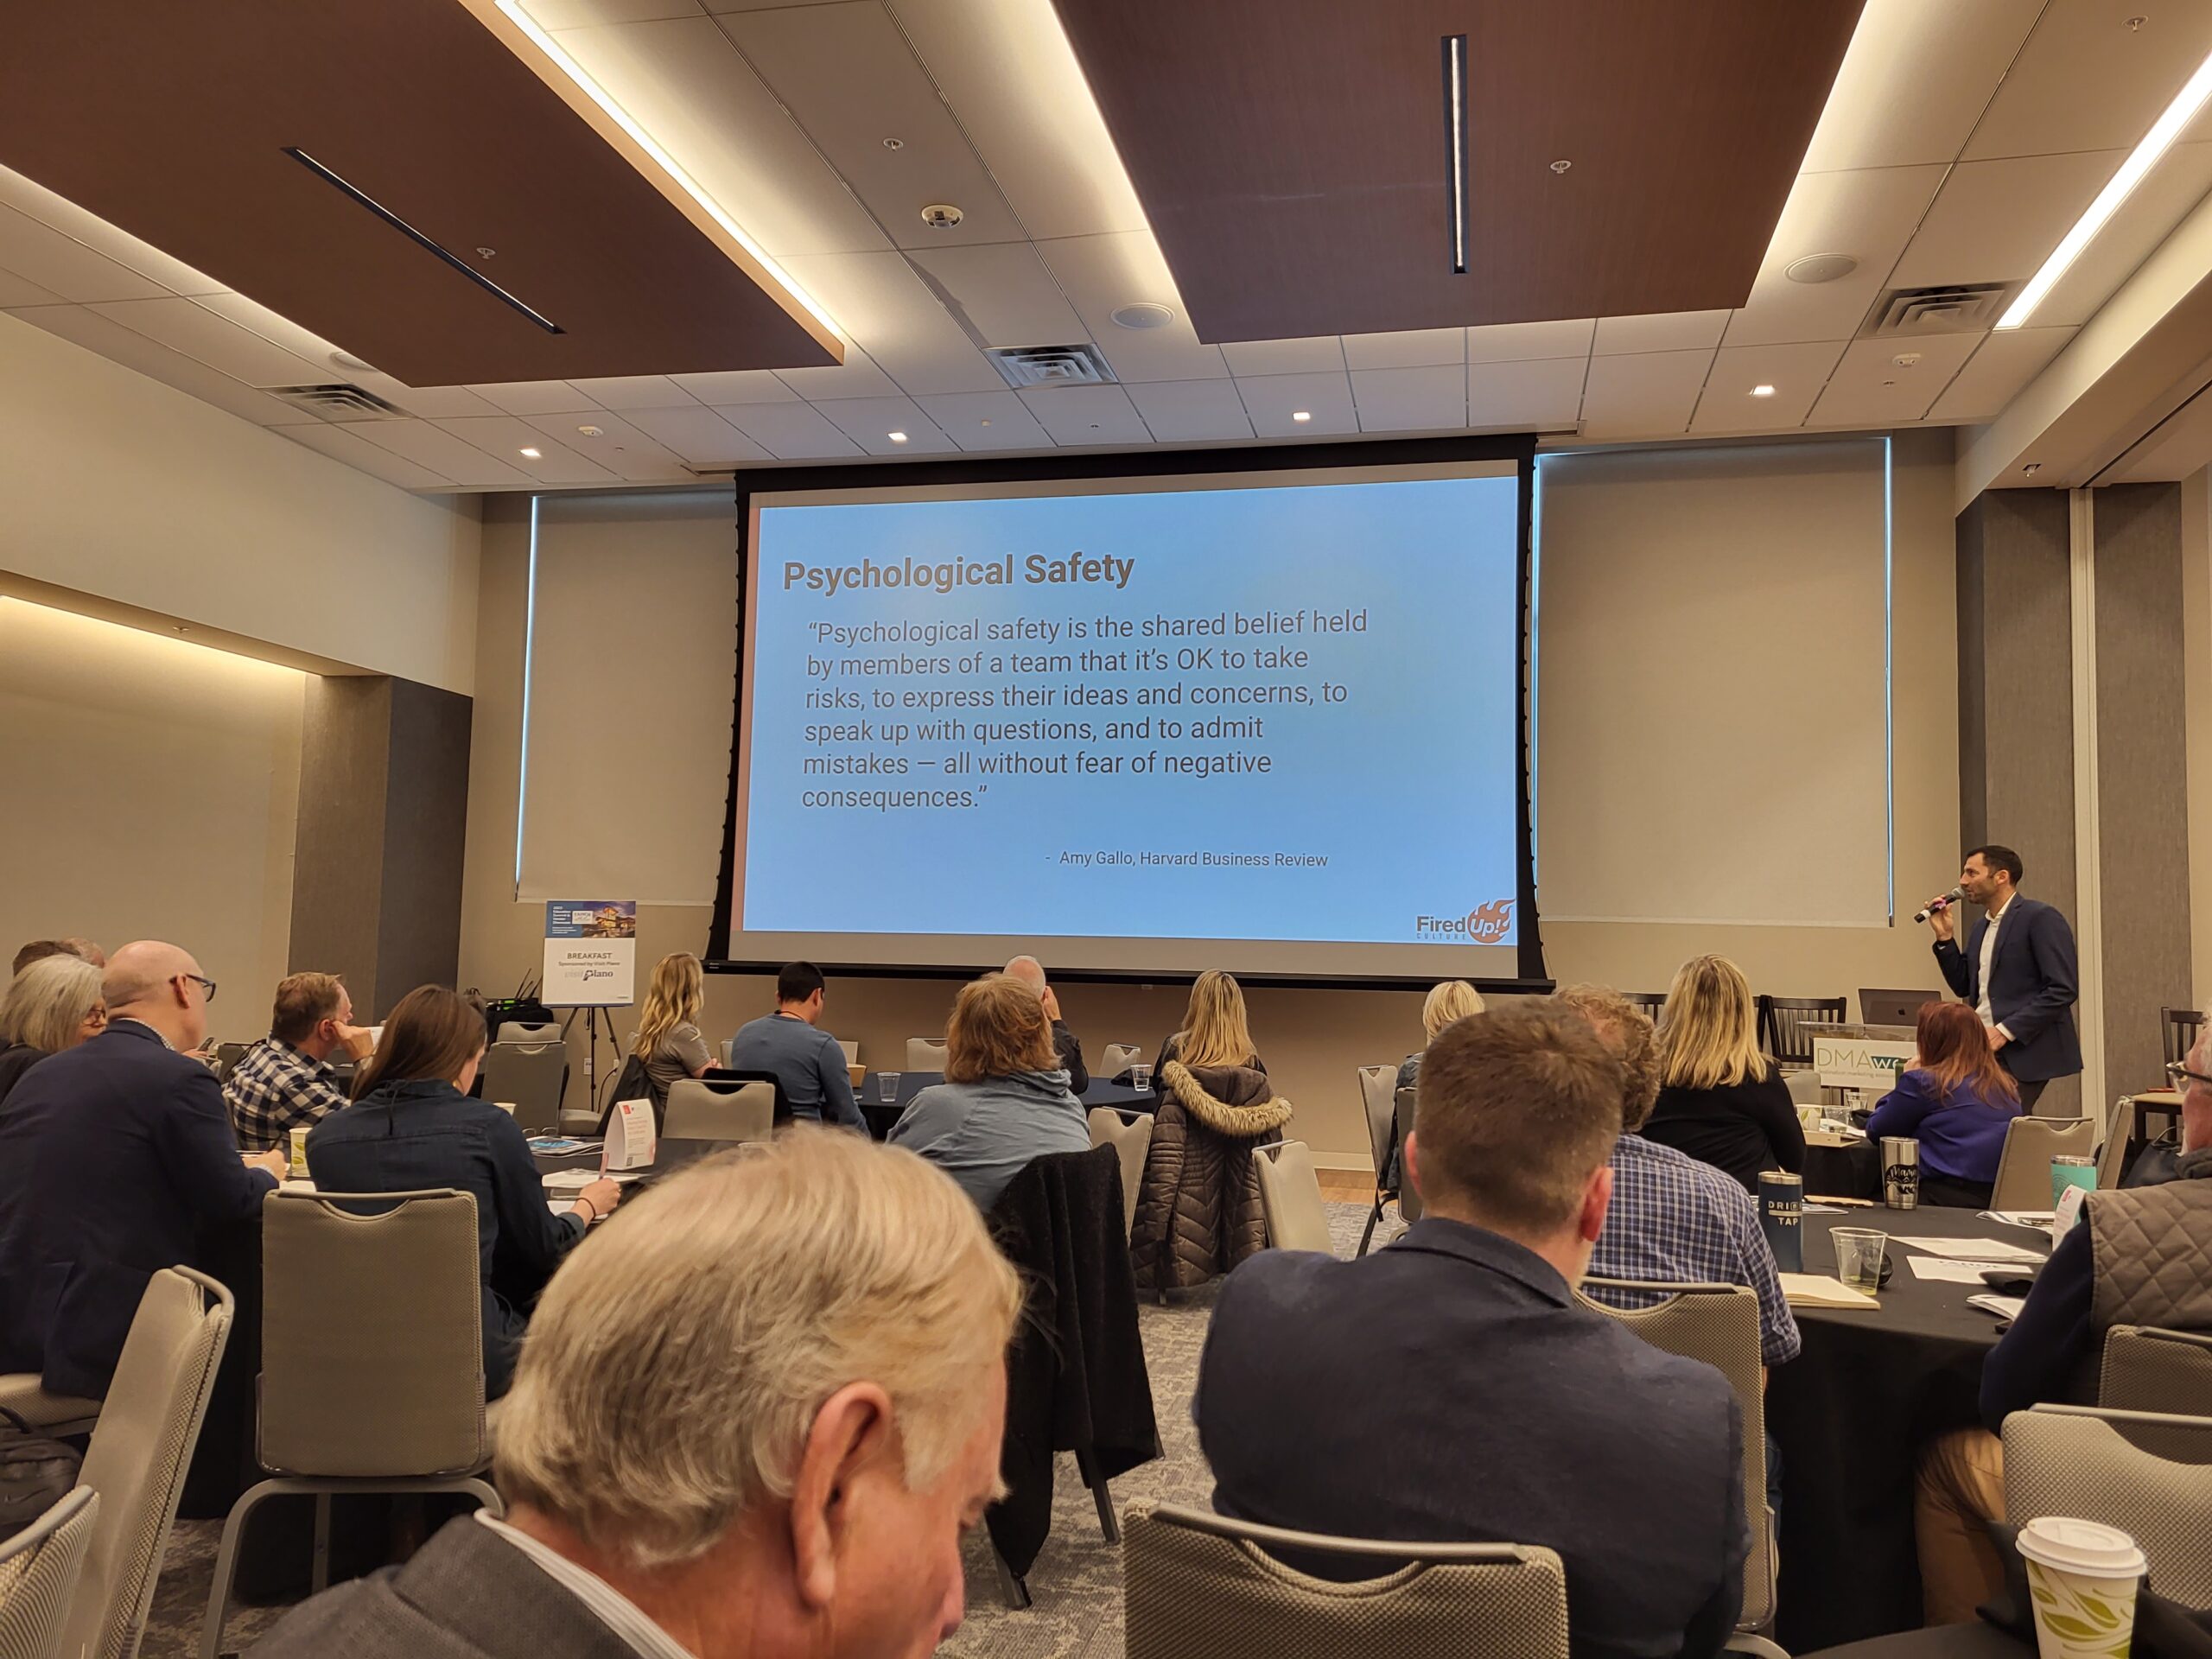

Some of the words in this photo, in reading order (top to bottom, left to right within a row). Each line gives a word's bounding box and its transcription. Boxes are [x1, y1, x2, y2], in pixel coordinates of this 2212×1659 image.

[785, 554, 1013, 596] Psychological
[1025, 551, 1135, 589] Safety
[809, 619, 979, 648] “Psychological
[987, 617, 1060, 645] safety
[1068, 616, 1087, 638] is
[1095, 615, 1133, 638] the
[1141, 613, 1224, 638] shared
[1234, 610, 1305, 635] belief
[1313, 609, 1366, 633] held
[808, 655, 833, 681] by
[841, 653, 950, 676] members
[959, 652, 984, 674] of
[990, 658, 1002, 674] a
[1010, 653, 1071, 674] team
[1079, 649, 1127, 672] that
[1136, 648, 1168, 671] it’s
[1178, 648, 1213, 671] OK
[1220, 650, 1245, 670] to
[1253, 645, 1308, 669] take
[807, 687, 865, 711] risks,
[872, 689, 894, 709] to
[903, 690, 994, 713] express
[1001, 684, 1056, 707] their
[1064, 682, 1128, 706] ideas
[1136, 682, 1182, 705] and
[1191, 686, 1314, 707] concerns,
[1321, 682, 1347, 703] to
[805, 719, 874, 747] speak
[881, 725, 909, 747] up
[917, 718, 964, 741] with
[974, 718, 1096, 746] questions,
[1106, 716, 1150, 740] and
[1158, 719, 1183, 740] to
[1192, 715, 1263, 739] admit
[804, 752, 909, 775] mistakes
[944, 752, 969, 774] all
[978, 751, 1068, 774] without
[1076, 751, 1124, 774] fear
[1132, 750, 1158, 773] of
[1165, 751, 1272, 779] negative
[803, 785, 988, 813] consequences.”
[1059, 850, 1092, 868] Amy
[1096, 850, 1135, 867] Gallo,
[1141, 851, 1198, 865] Harvard
[1203, 852, 1270, 866] Business
[1274, 852, 1328, 867] Review
[1416, 916, 1466, 932] Fired
[1470, 918, 1502, 938] Up!
[1777, 1217, 1798, 1226] TAP
